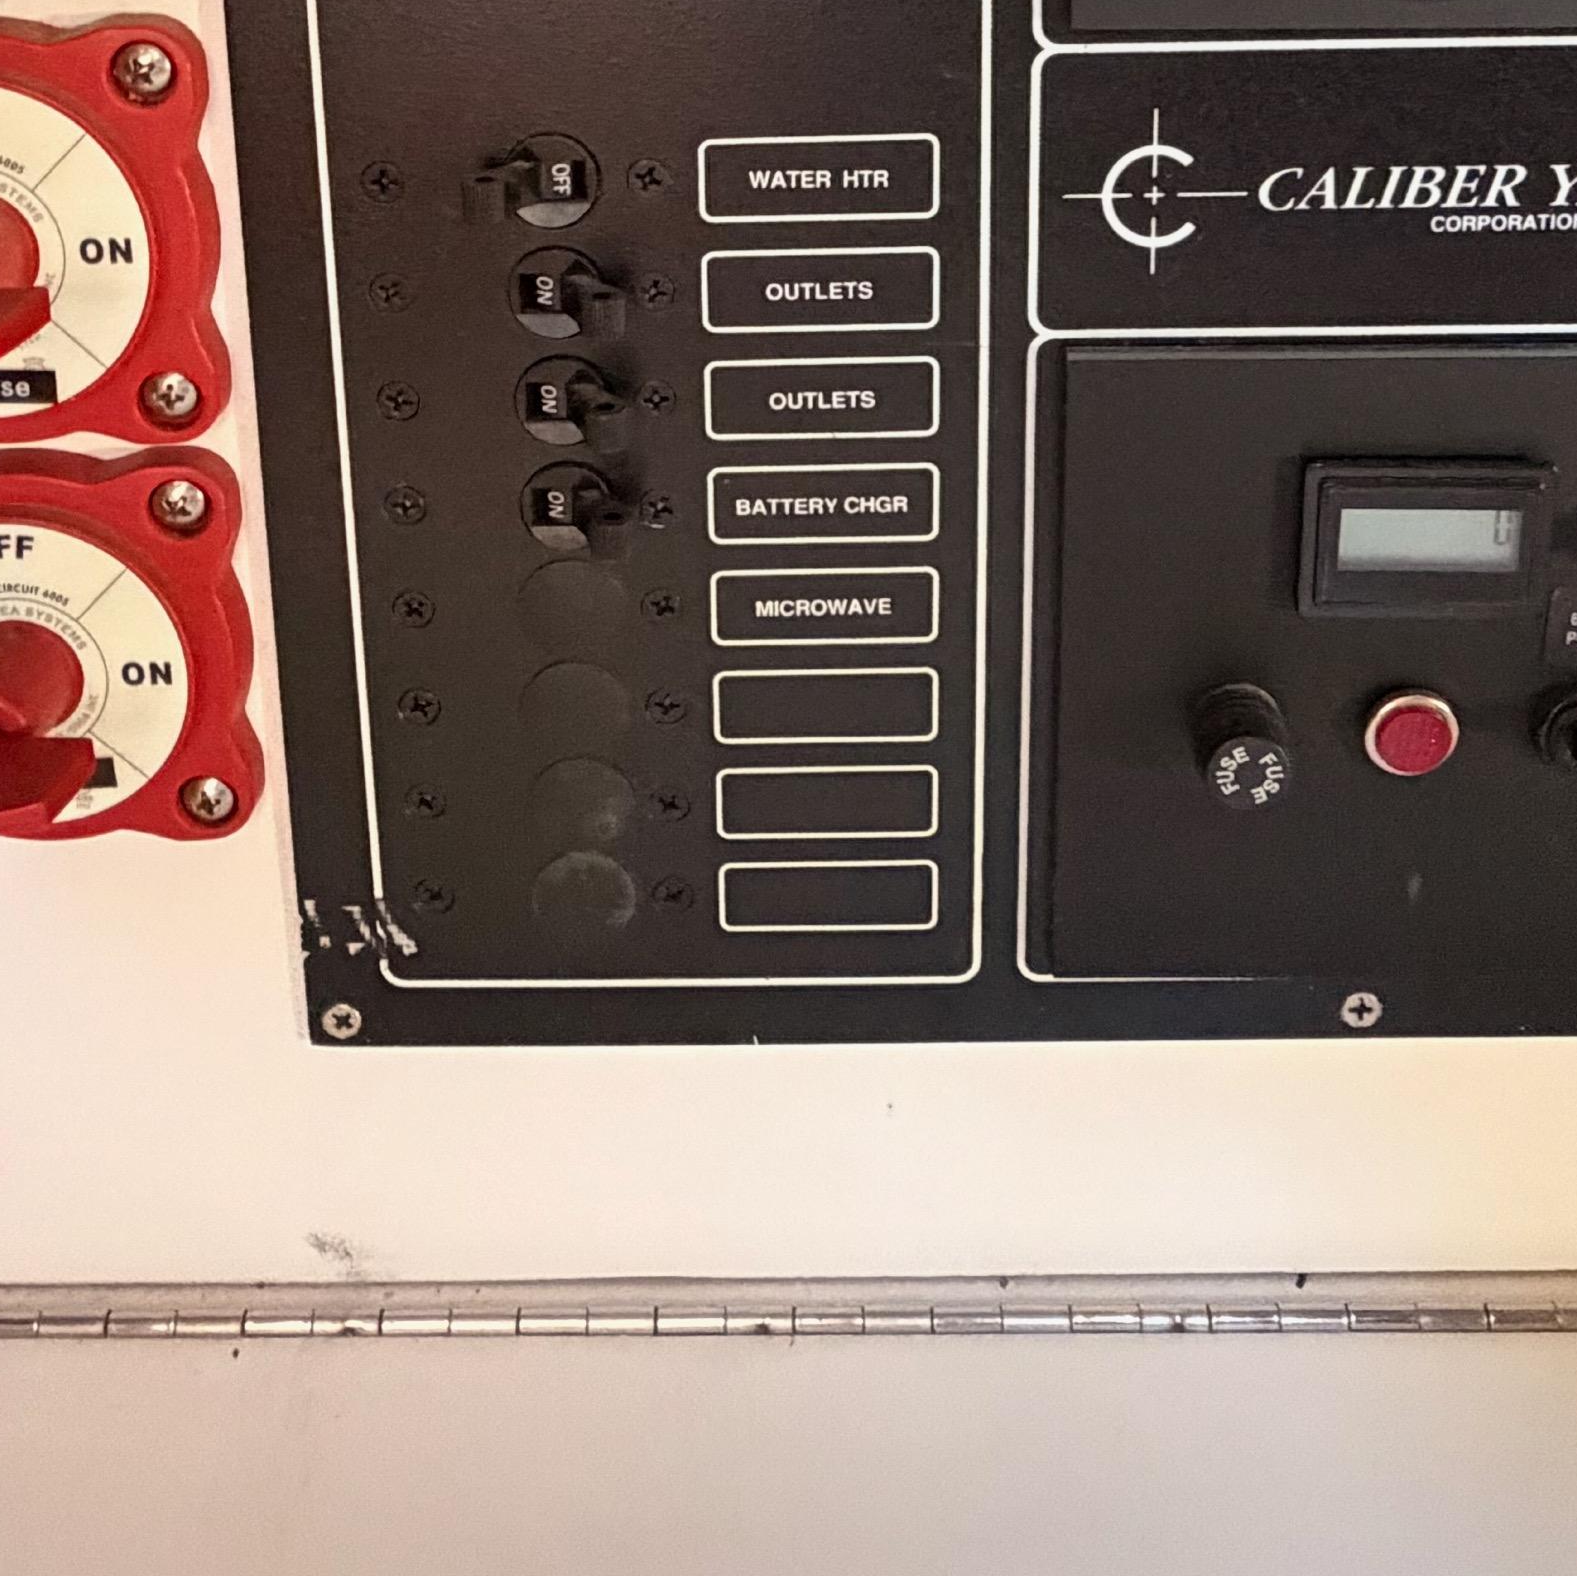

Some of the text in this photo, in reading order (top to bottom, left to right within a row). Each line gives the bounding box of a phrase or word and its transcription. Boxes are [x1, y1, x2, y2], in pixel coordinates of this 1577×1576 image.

[749, 168, 890, 190] WATER HTR
[1258, 161, 1525, 211] CALIBER
[79, 237, 134, 265] ON
[765, 281, 874, 302] OUTLETS
[769, 391, 876, 411] OUTLETS
[735, 495, 908, 517] BATTERY CHGR
[755, 597, 892, 619] MICROWAVE
[121, 661, 173, 686] ON
[1215, 746, 1250, 796] FUSE
[1250, 752, 1285, 805] FUSE
